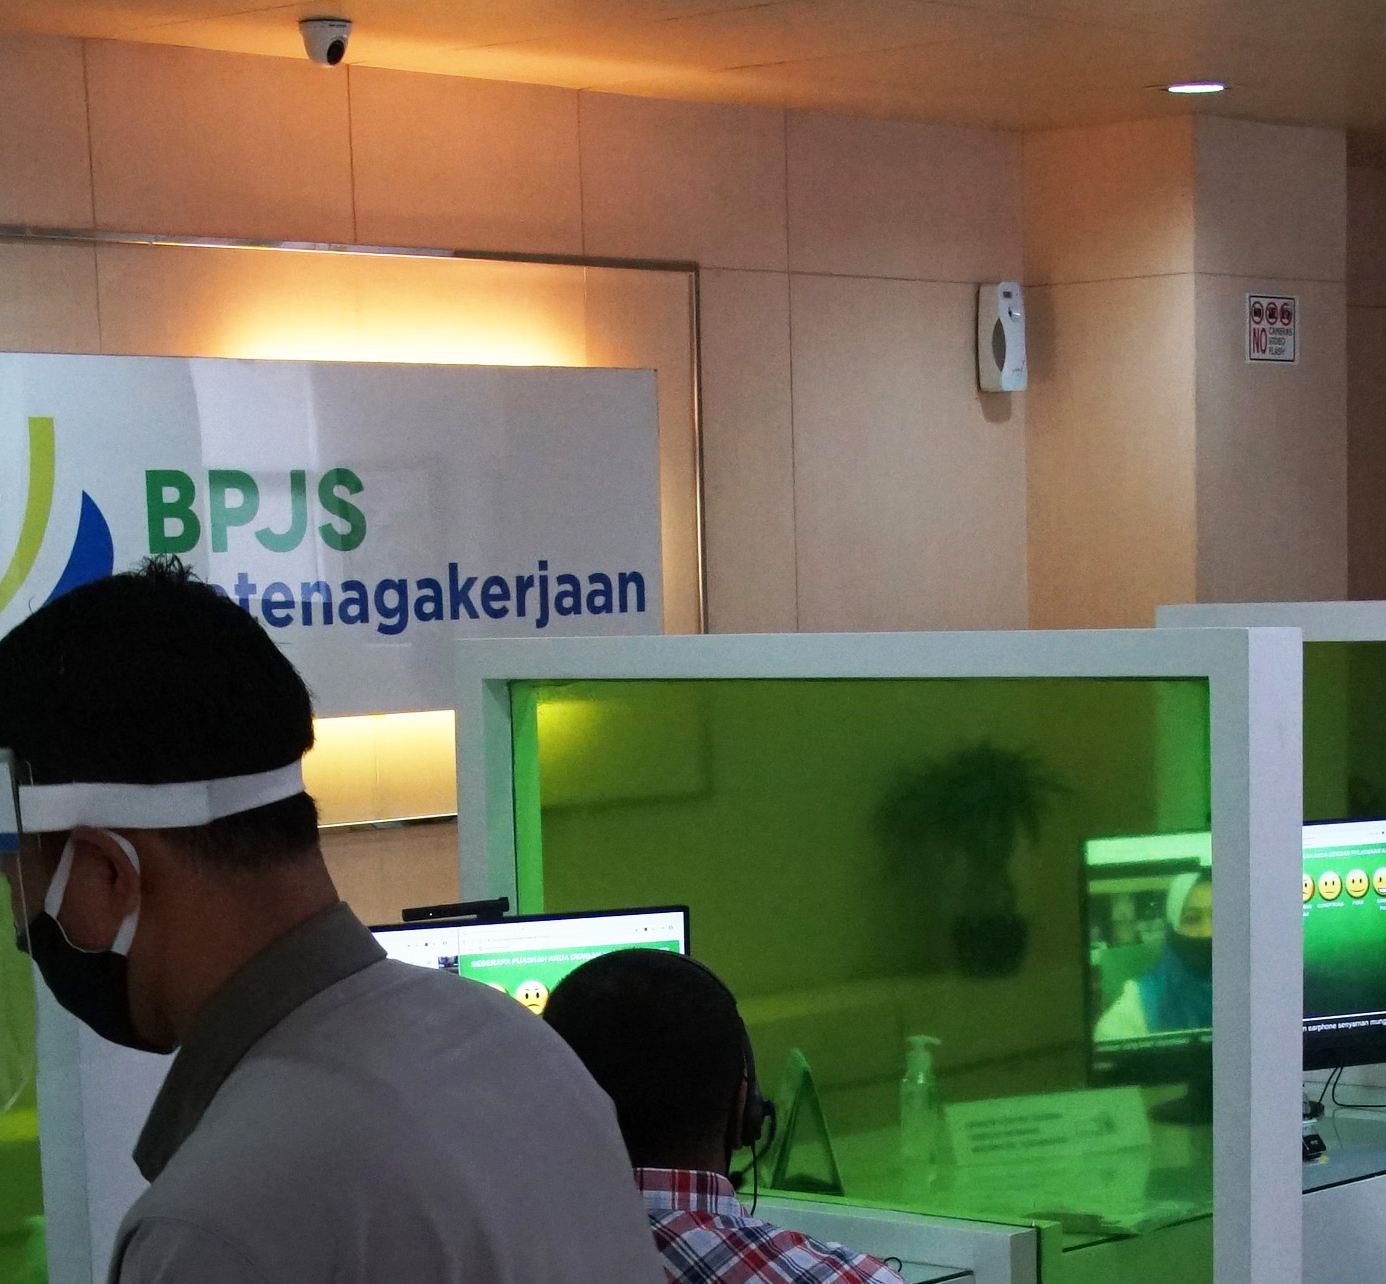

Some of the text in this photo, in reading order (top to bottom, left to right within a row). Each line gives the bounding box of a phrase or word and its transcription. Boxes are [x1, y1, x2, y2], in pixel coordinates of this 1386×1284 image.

[1252, 327, 1268, 355] NO
[145, 468, 367, 554] BPJS
[215, 560, 647, 636] tenagakerjaan
[471, 959, 511, 968] SEBERAPA
[512, 955, 548, 965] PUASKAH
[549, 953, 570, 963] ANDA
[1308, 1023, 1337, 1032] earphone
[1337, 1019, 1369, 1029] senyaman
